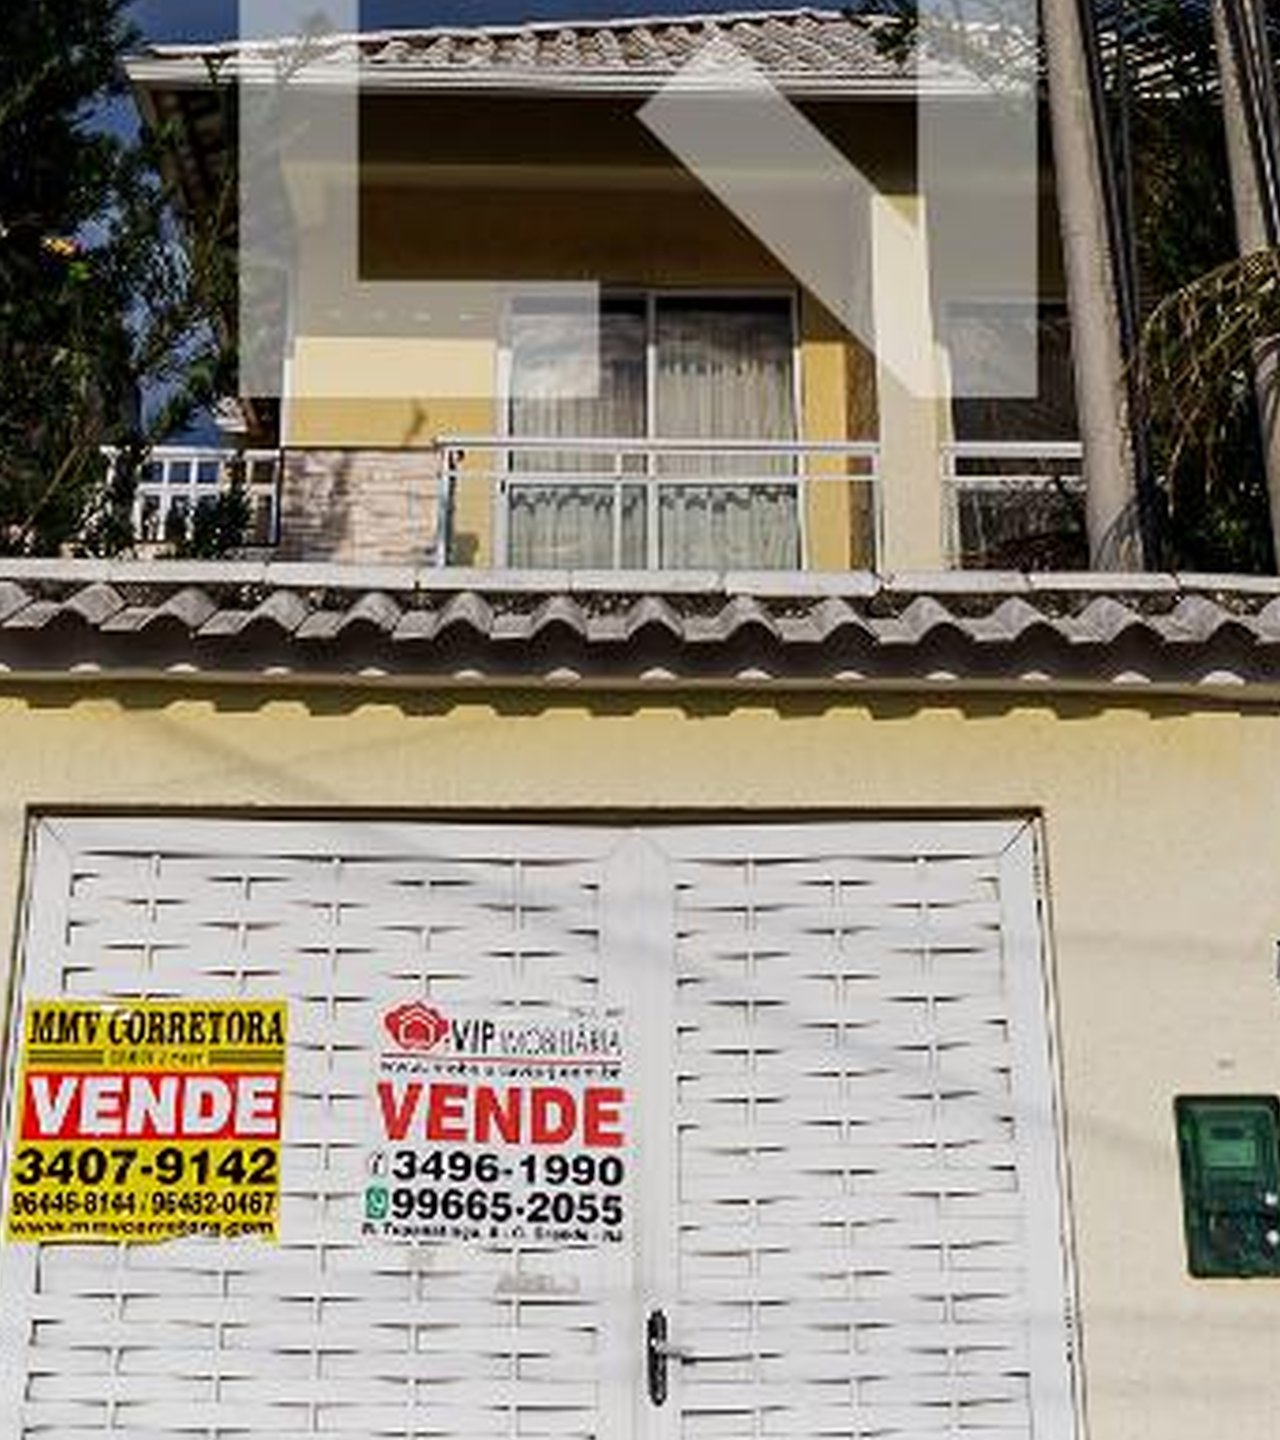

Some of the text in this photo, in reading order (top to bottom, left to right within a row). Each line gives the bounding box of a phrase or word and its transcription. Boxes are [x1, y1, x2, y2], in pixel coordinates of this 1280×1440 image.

[29, 1009, 285, 1045] MMV CORRETORA
[452, 1019, 495, 1054] VIP
[29, 1075, 278, 1135] VENDE
[377, 1083, 625, 1148] VENDE
[14, 1147, 278, 1186] 3407-9142
[392, 1151, 625, 1187] 3496-1990
